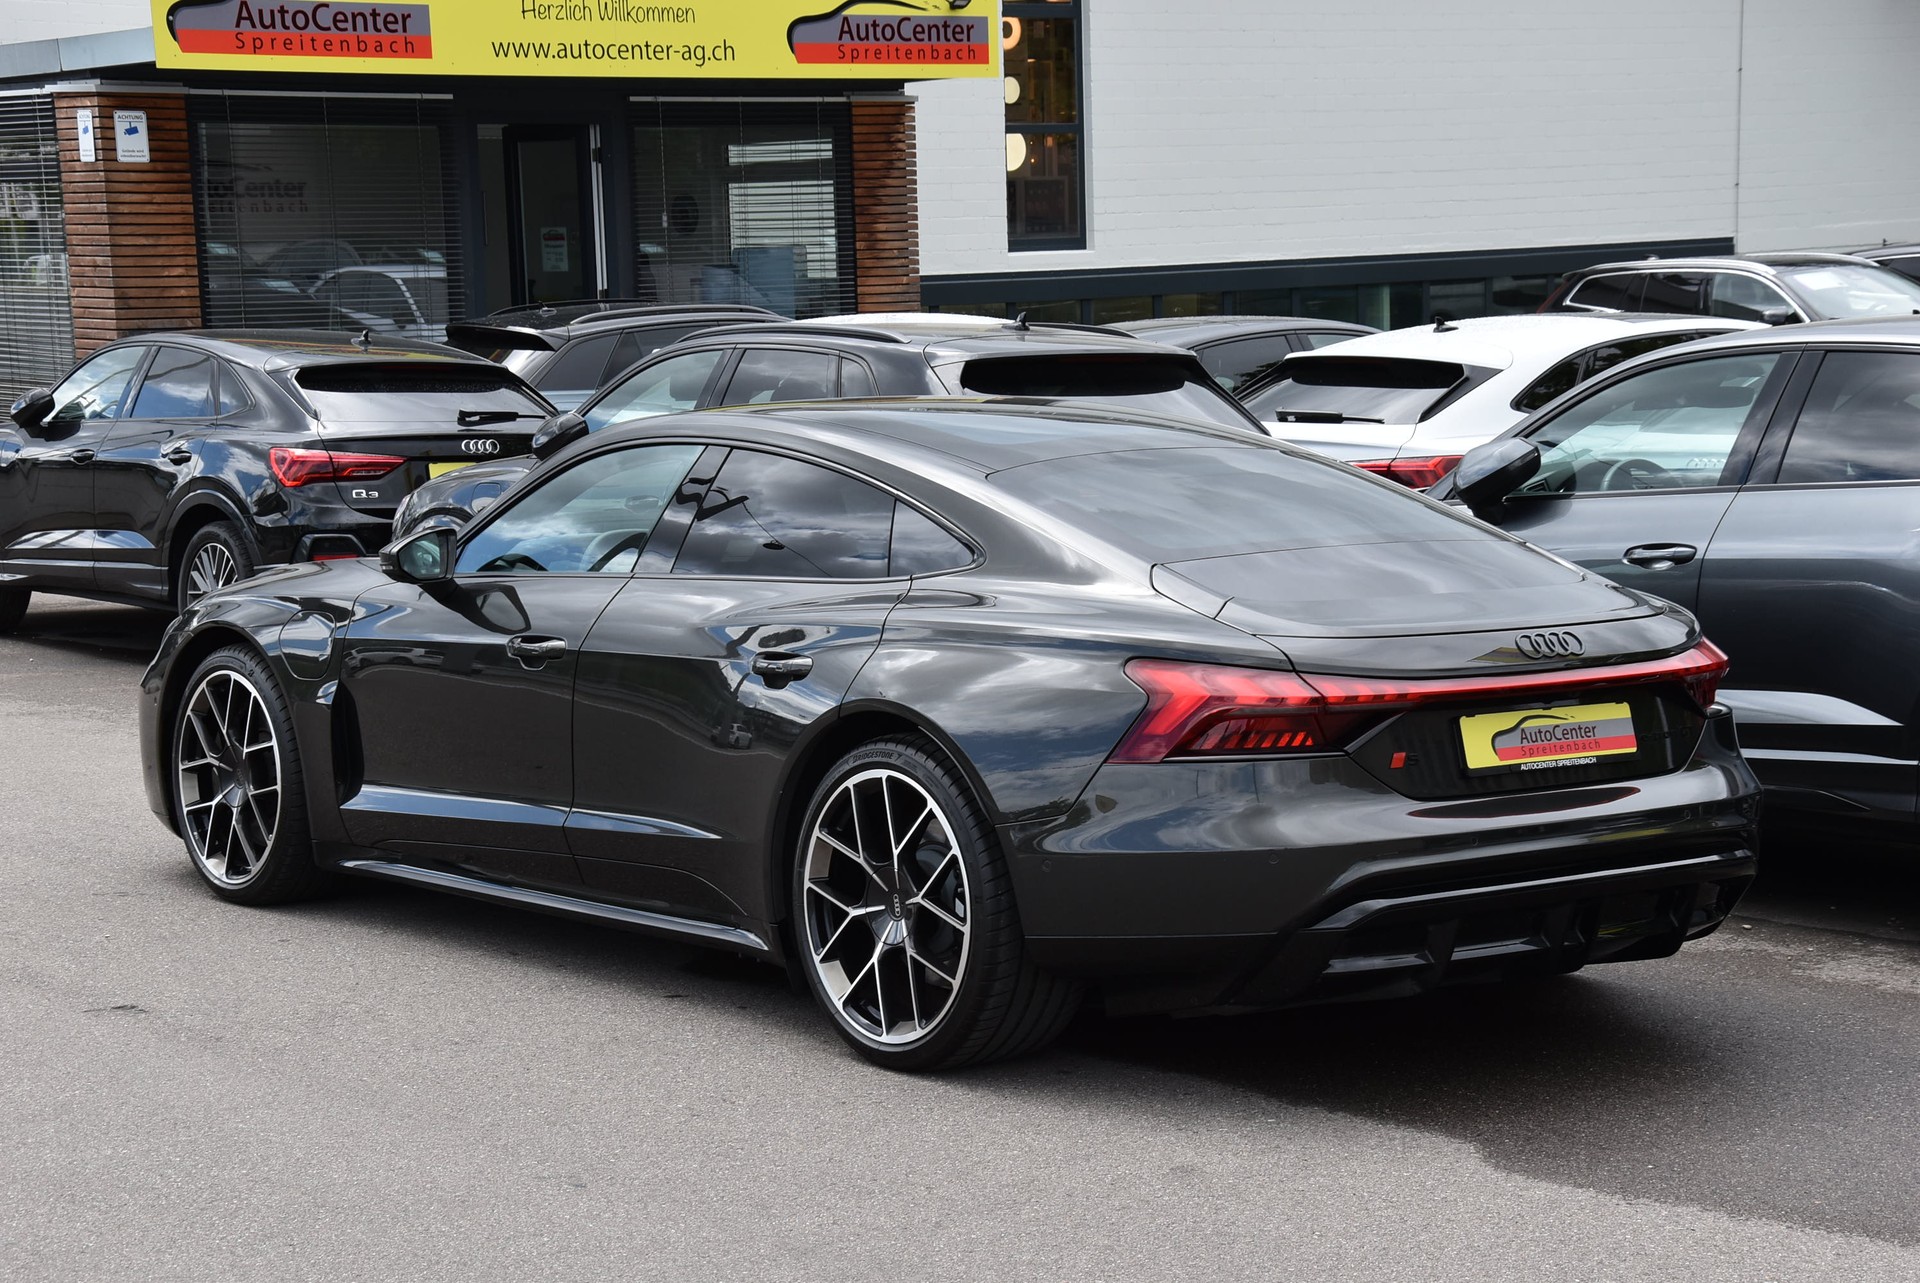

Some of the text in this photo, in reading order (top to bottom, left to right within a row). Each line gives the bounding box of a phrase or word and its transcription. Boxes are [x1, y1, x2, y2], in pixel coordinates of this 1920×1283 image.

[235, 0, 412, 34] AutoCenter
[521, 0, 696, 24] Herzlich Willkommen
[838, 15, 975, 43] AutoCenter
[235, 31, 415, 55] Spreitenbach
[491, 39, 736, 67] www.autocenter-ag.ch
[838, 44, 976, 63] Spreitenbach
[352, 489, 379, 499] Q3
[1520, 724, 1597, 745] AutoCenter
[1521, 739, 1601, 758] Spreitenbach
[1520, 757, 1597, 771] AUTOCENTER SPREITENBACH
